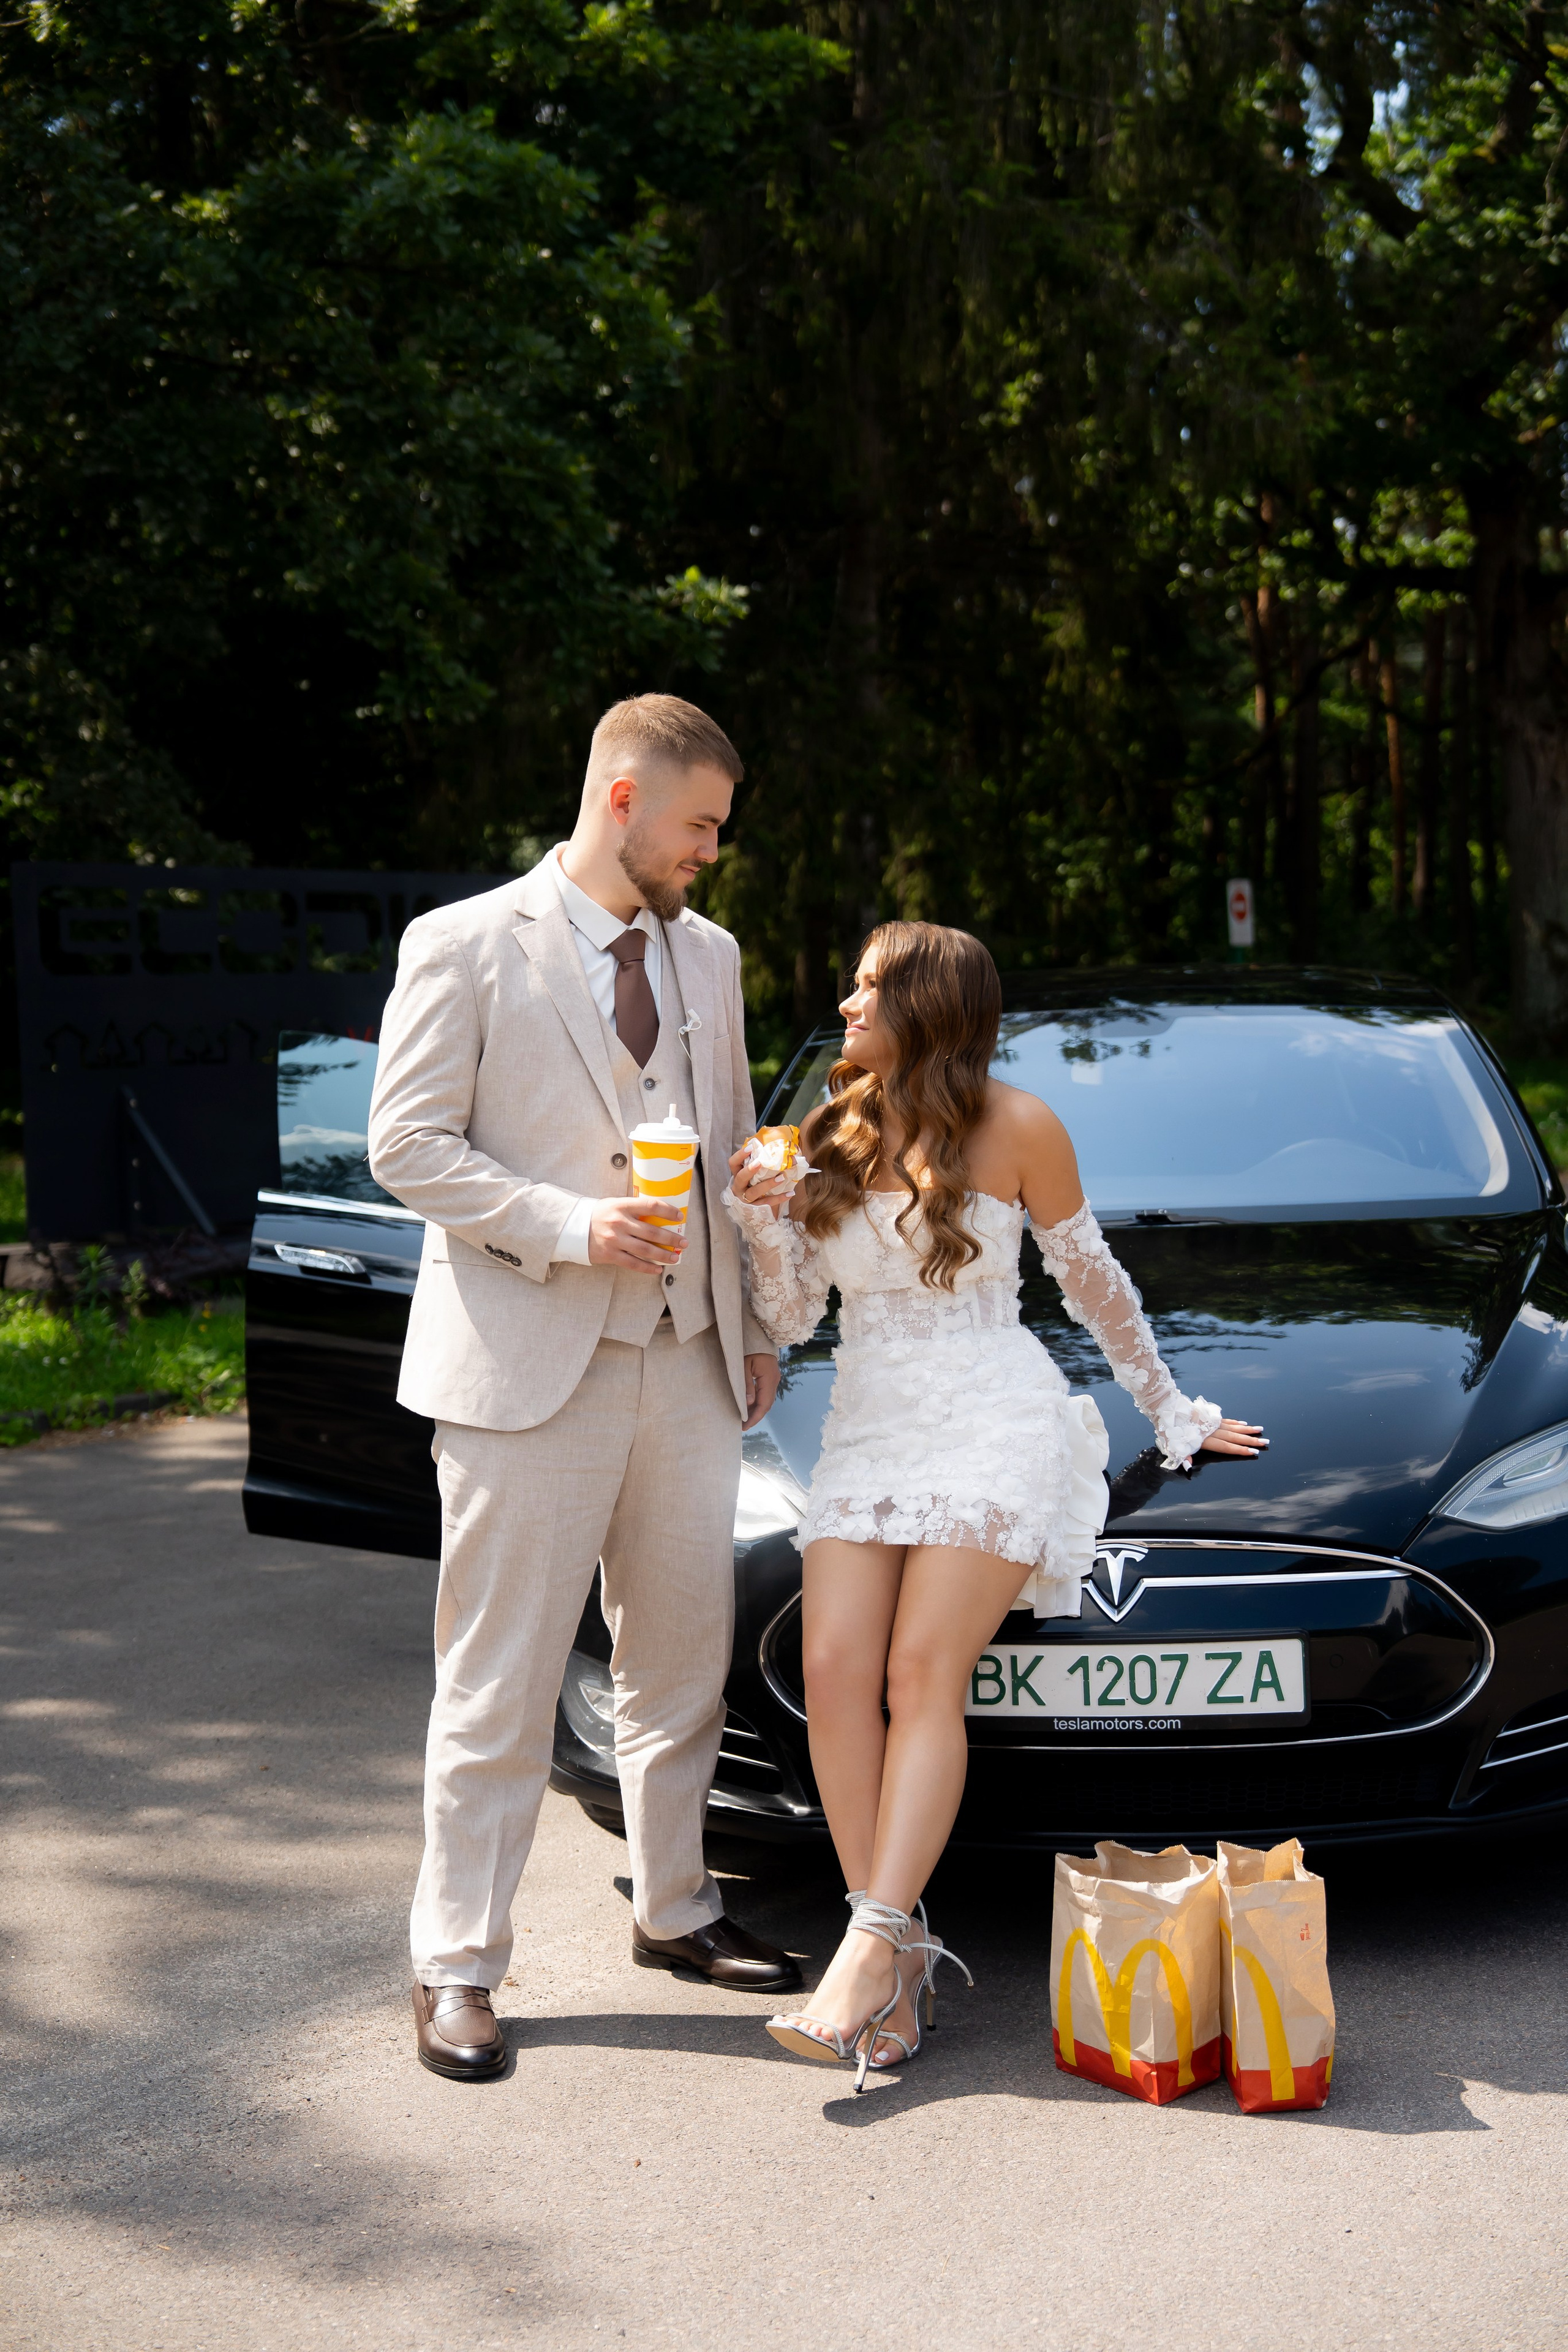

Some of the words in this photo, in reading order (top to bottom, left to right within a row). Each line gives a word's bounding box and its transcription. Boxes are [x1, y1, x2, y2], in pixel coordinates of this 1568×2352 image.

[37, 885, 439, 975] ECODI
[971, 1654, 1046, 1706] BK
[1066, 1653, 1189, 1706] 1207
[1205, 1650, 1285, 1704] ZA
[1053, 1717, 1182, 1730] teslamotors.com
